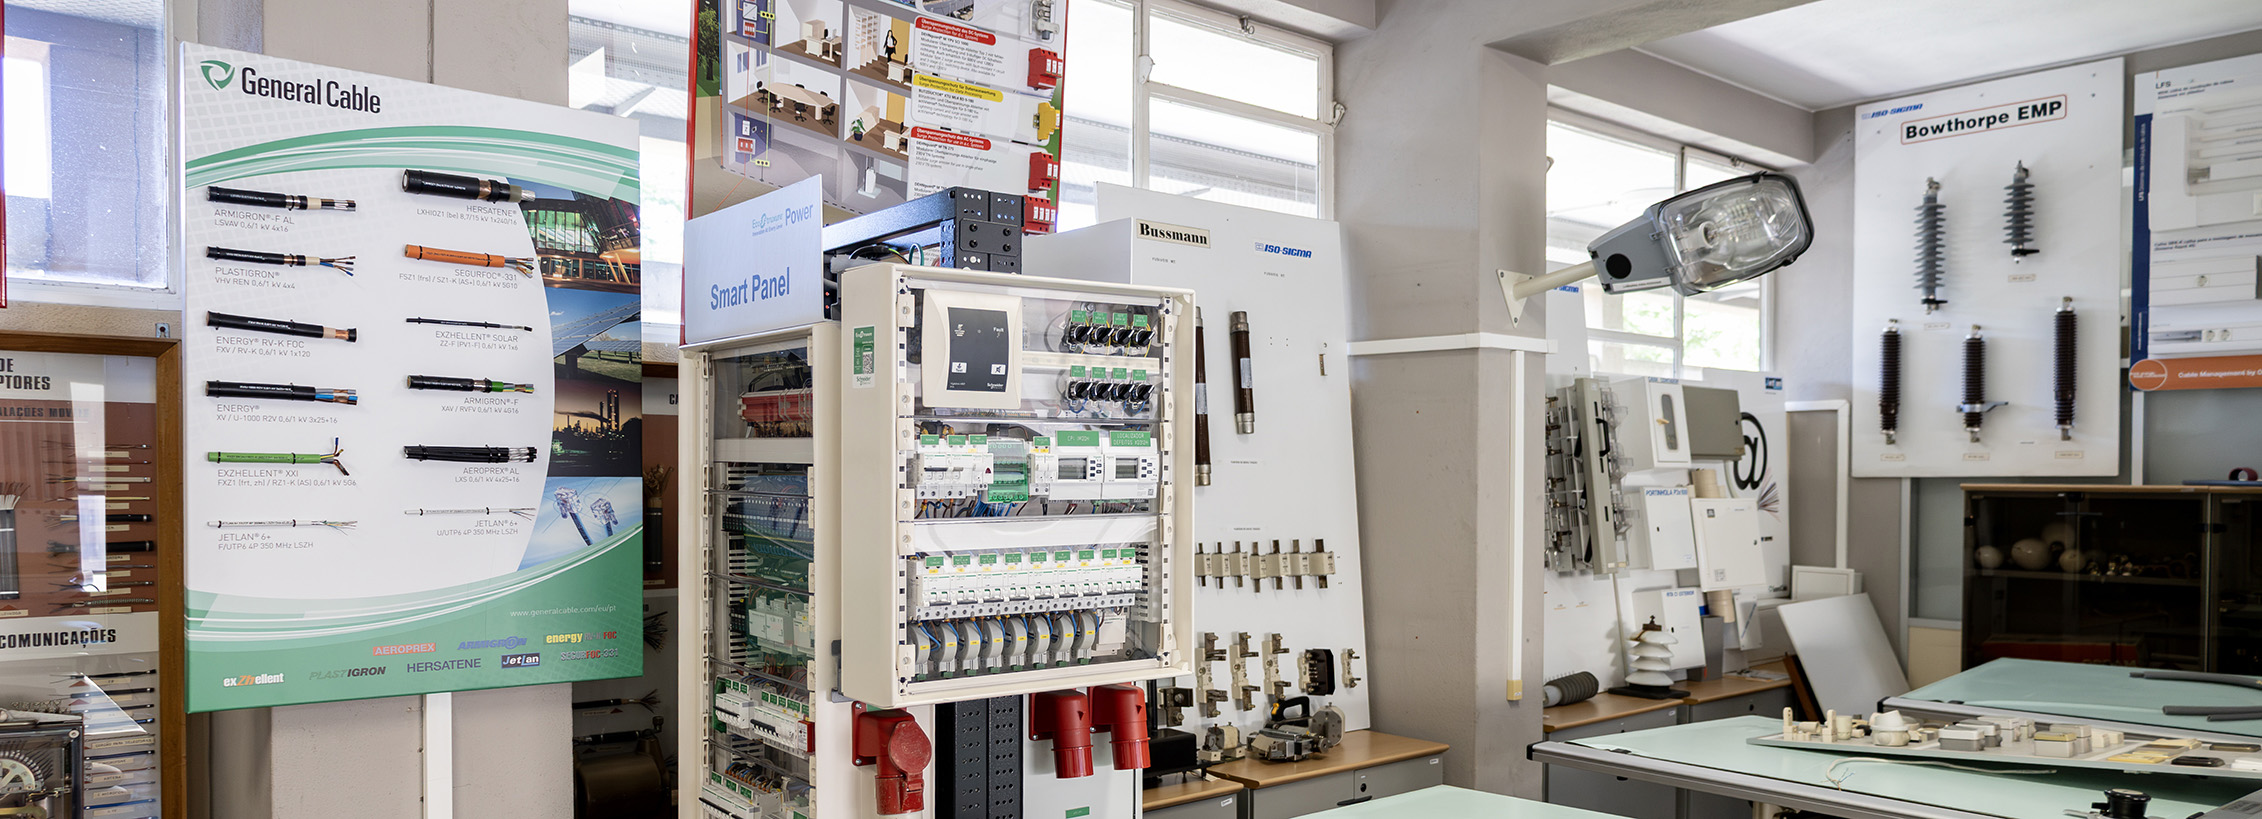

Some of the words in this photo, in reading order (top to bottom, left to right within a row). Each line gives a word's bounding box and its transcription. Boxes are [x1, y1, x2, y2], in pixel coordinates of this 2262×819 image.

[241, 67, 321, 105] General
[327, 80, 381, 114] Cable
[1906, 111, 2009, 139] Bowthorpe
[2018, 101, 2062, 122] EMP
[786, 204, 813, 226] Power
[261, 222, 269, 230] kV
[1140, 223, 1207, 244] Bussmann
[1265, 244, 1312, 258] ISO-SIGMA
[233, 278, 250, 286] REN
[711, 278, 748, 310] Smart
[752, 267, 790, 301] Panel
[262, 339, 284, 347] RV-K
[287, 340, 304, 348] FOC
[493, 334, 518, 342] SOLAR
[510, 604, 616, 617] www.generalcable.com/eu/pt
[0, 627, 116, 649] COMUNICAÇÕES
[457, 636, 527, 650] ARMIGRON
[546, 632, 583, 644] energy
[603, 631, 617, 640] FOC
[374, 643, 434, 656] AEROPREX
[407, 658, 481, 673] HERSATENE
[502, 654, 539, 667] JetLan
[223, 673, 284, 687] exZhellent
[309, 666, 386, 680] PLASTIGRON
